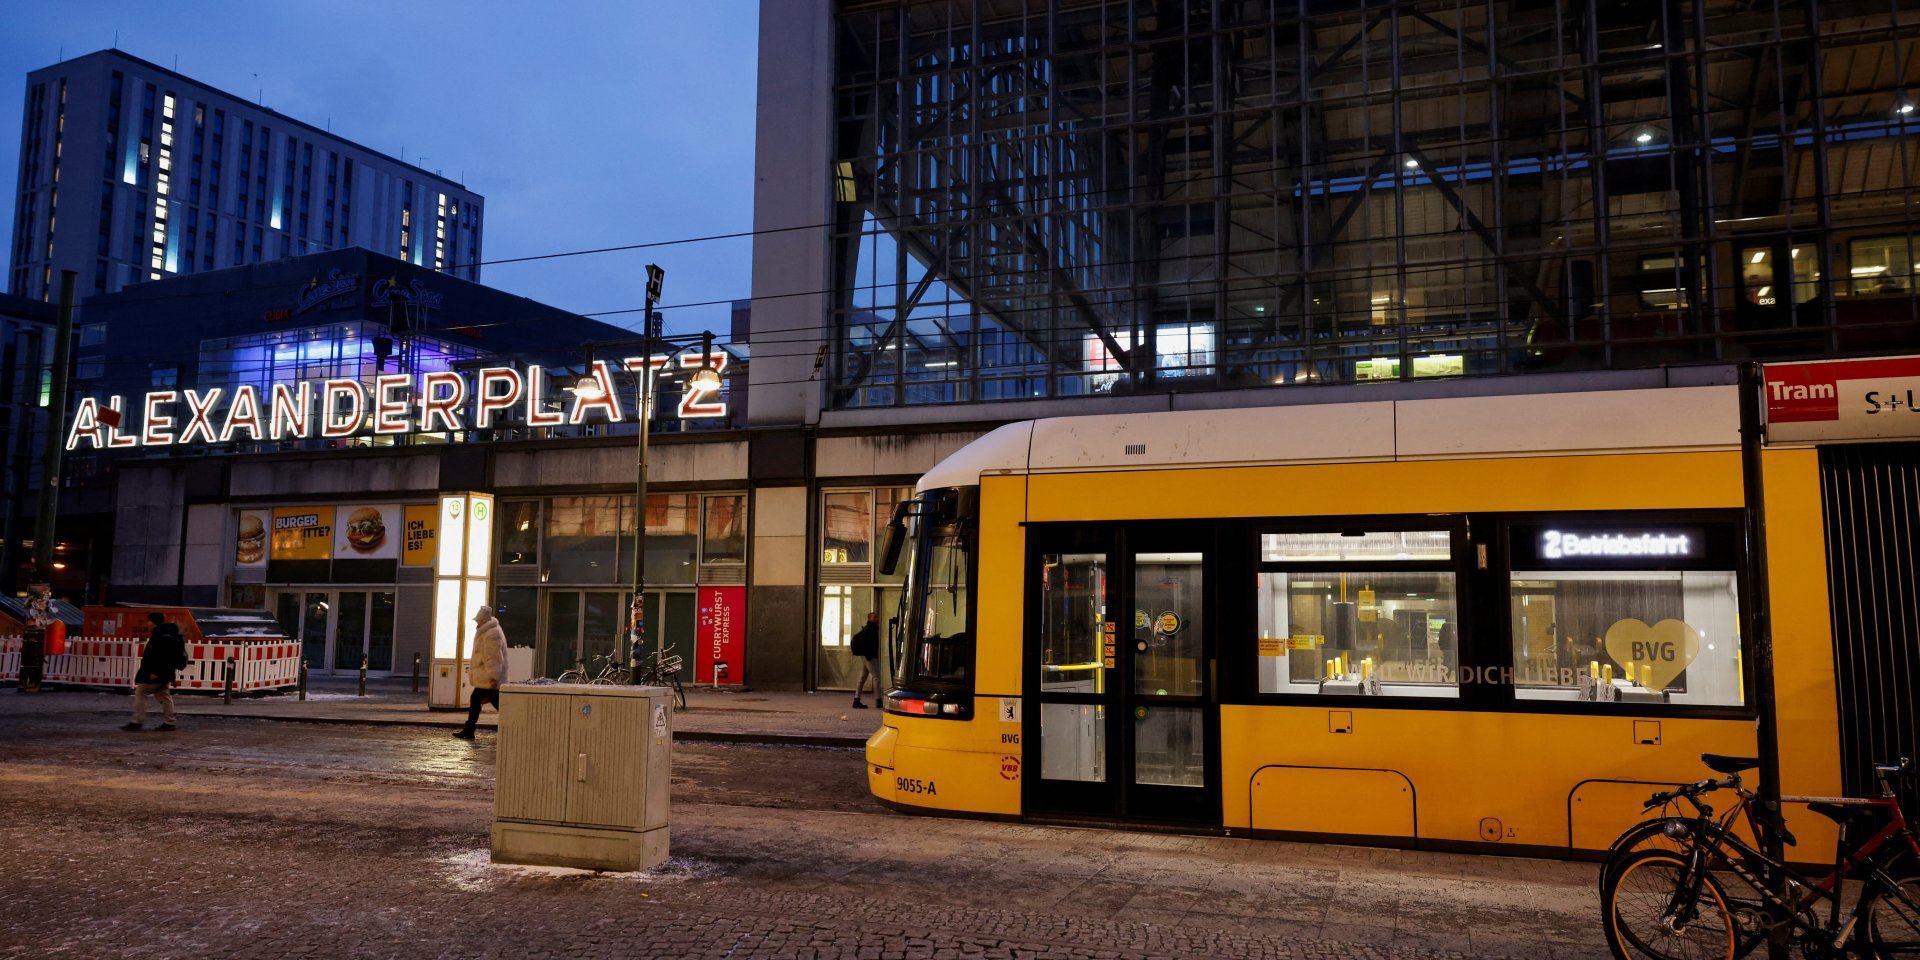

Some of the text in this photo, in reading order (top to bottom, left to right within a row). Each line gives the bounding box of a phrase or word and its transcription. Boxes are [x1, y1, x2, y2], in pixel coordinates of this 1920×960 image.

[650, 268, 662, 294] H
[66, 351, 728, 450] ALEXANDERPLATZ
[1768, 381, 1834, 400] Tram
[275, 515, 319, 529] BURGER
[407, 520, 424, 530] ICH
[407, 529, 434, 541] LIEBE
[1544, 530, 1689, 559] 2 Betriebsfahrt
[407, 540, 423, 551] ES!
[713, 590, 723, 659] CURRYWURST
[722, 606, 730, 644] EXPRESS
[1631, 641, 1675, 661] BVG
[1405, 662, 1451, 684] WIR
[1459, 665, 1514, 686] DICH
[1001, 733, 1020, 744] BVG
[1002, 764, 1019, 773] VBB
[897, 776, 937, 796] 9055-A
